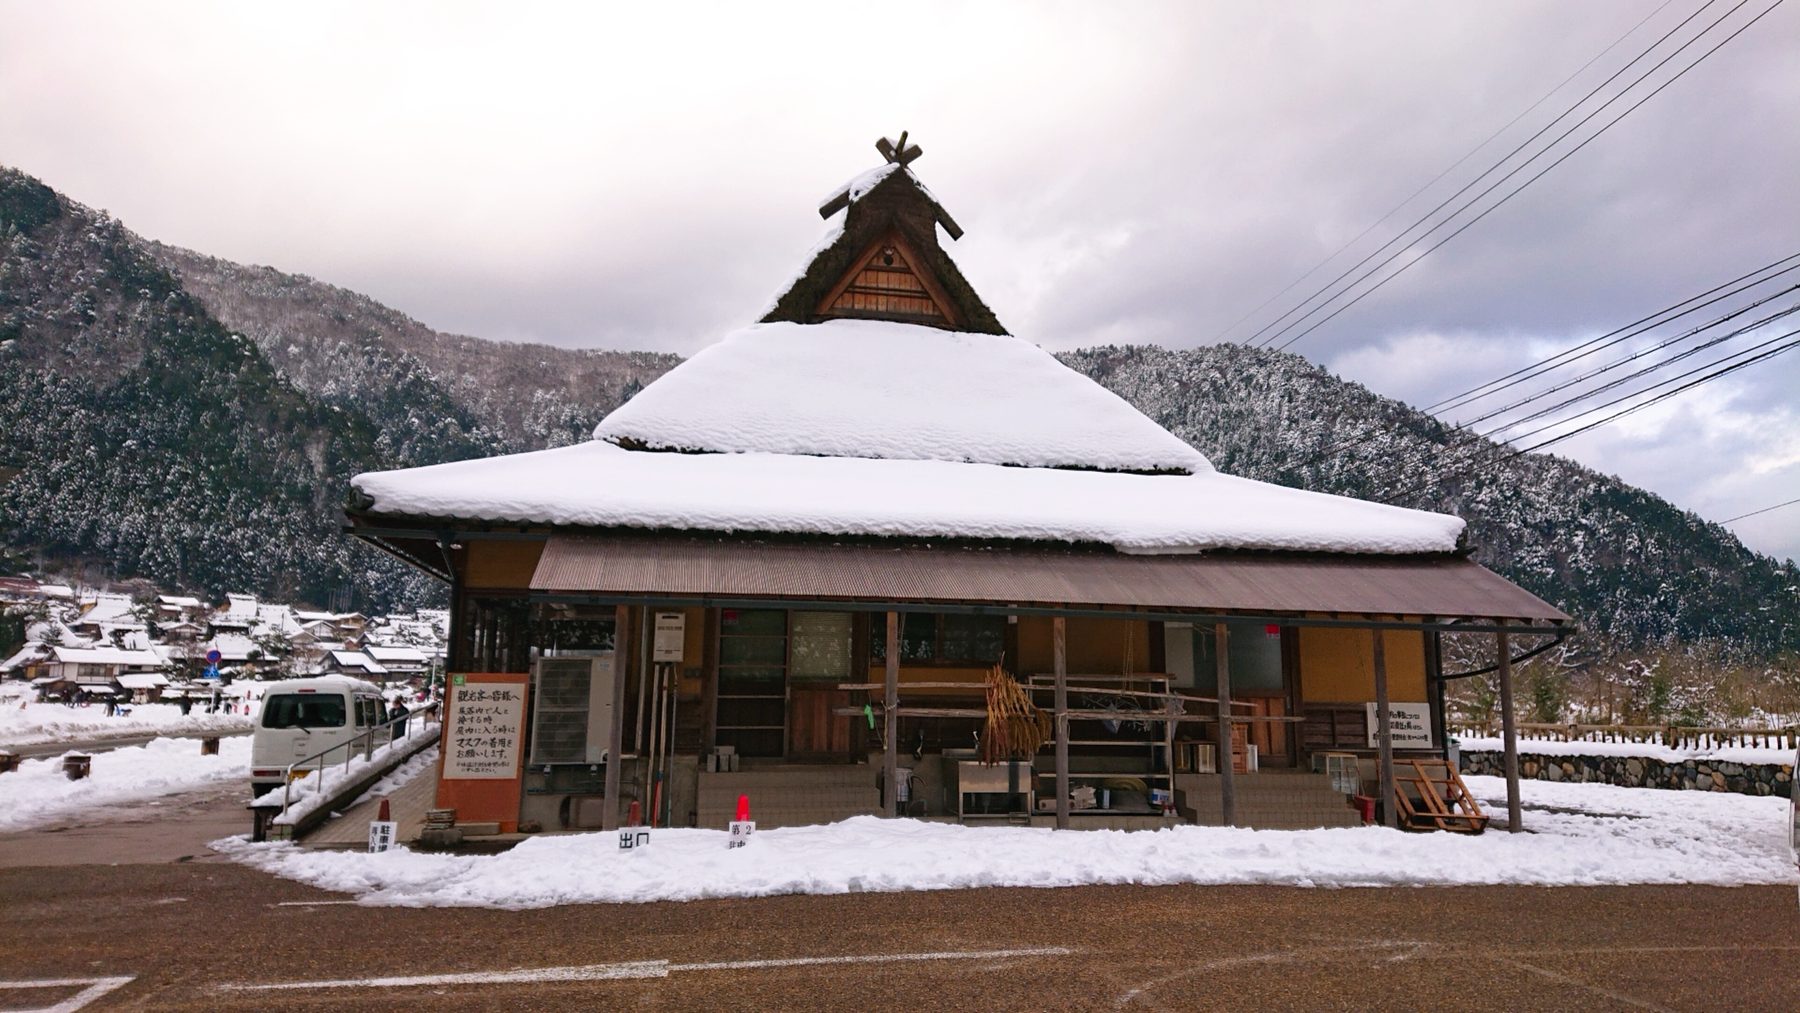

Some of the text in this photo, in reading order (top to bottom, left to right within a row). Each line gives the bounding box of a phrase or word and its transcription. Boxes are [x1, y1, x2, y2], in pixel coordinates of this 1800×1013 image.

[456, 737, 513, 748] マスクの着用を
[456, 748, 507, 759] お願いします。
[619, 832, 649, 849] 出口
